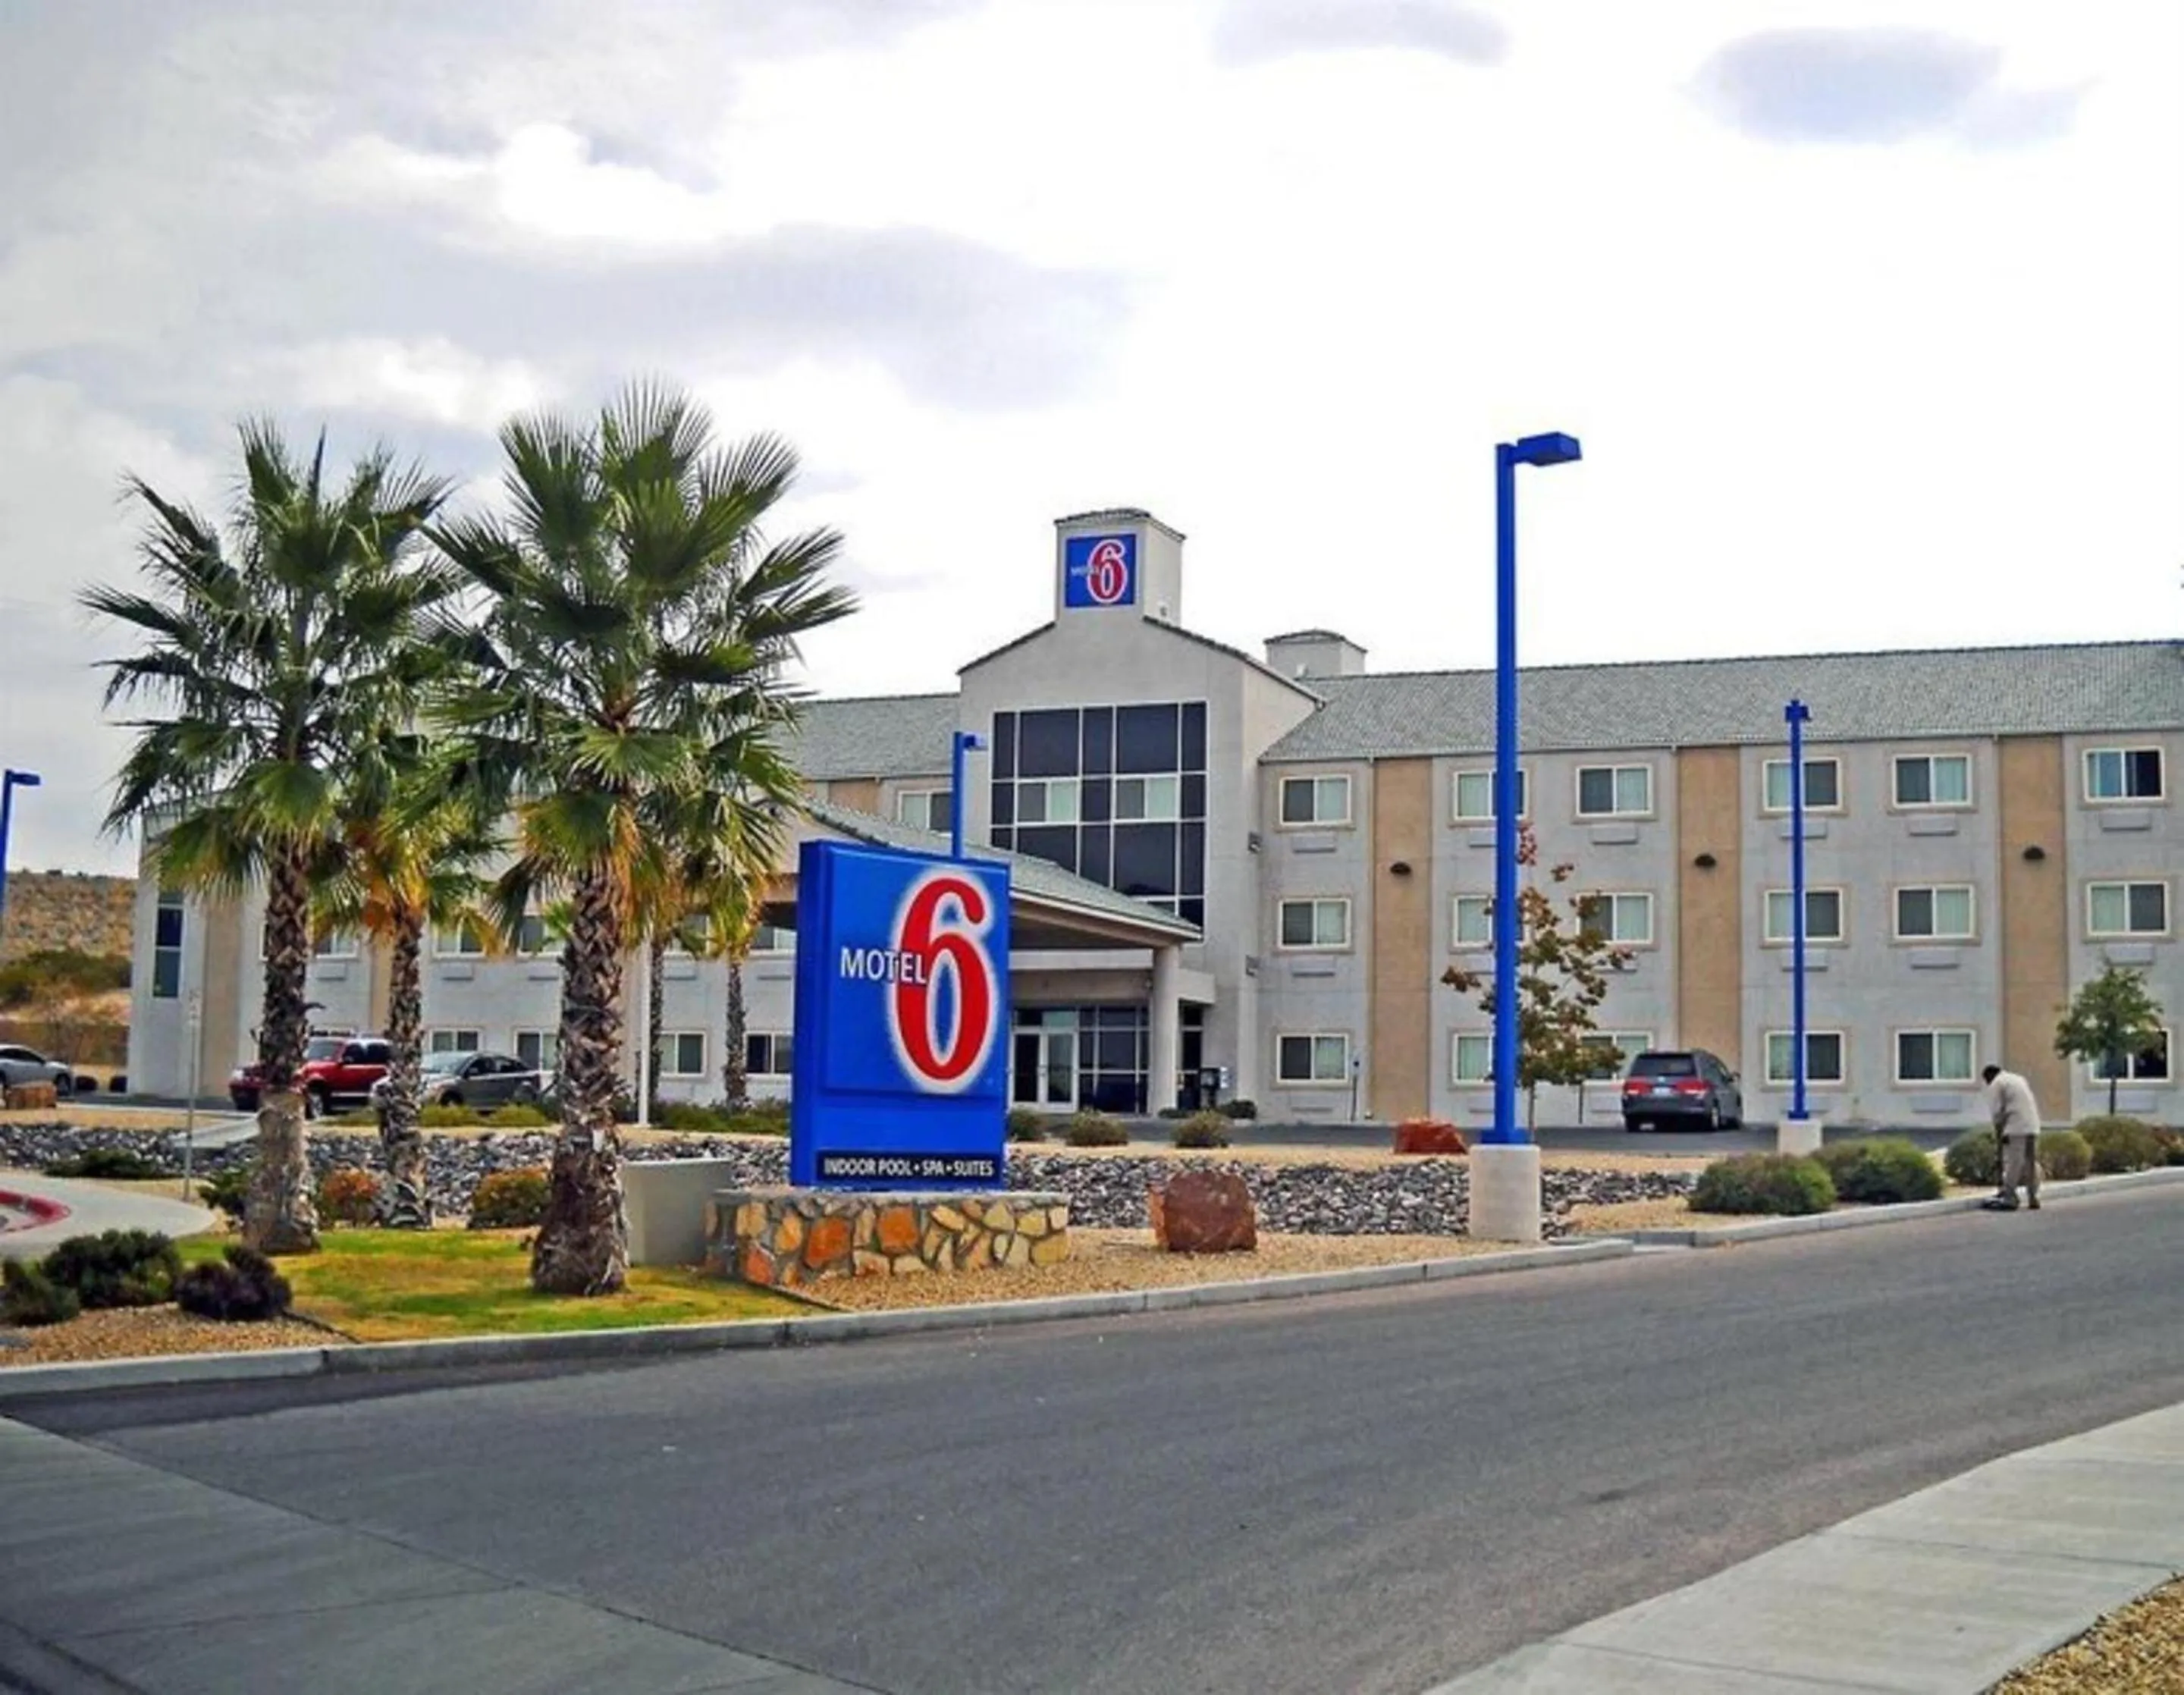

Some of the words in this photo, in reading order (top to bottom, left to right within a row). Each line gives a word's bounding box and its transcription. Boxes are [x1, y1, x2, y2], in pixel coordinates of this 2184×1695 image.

[1087, 539, 1128, 604] 6
[839, 946, 927, 984] MOTEL
[891, 871, 996, 1088] 6
[824, 1157, 876, 1175] INDOOR
[878, 1158, 912, 1176] POOL
[921, 1160, 945, 1176] SPA
[954, 1160, 995, 1177] SUITES
